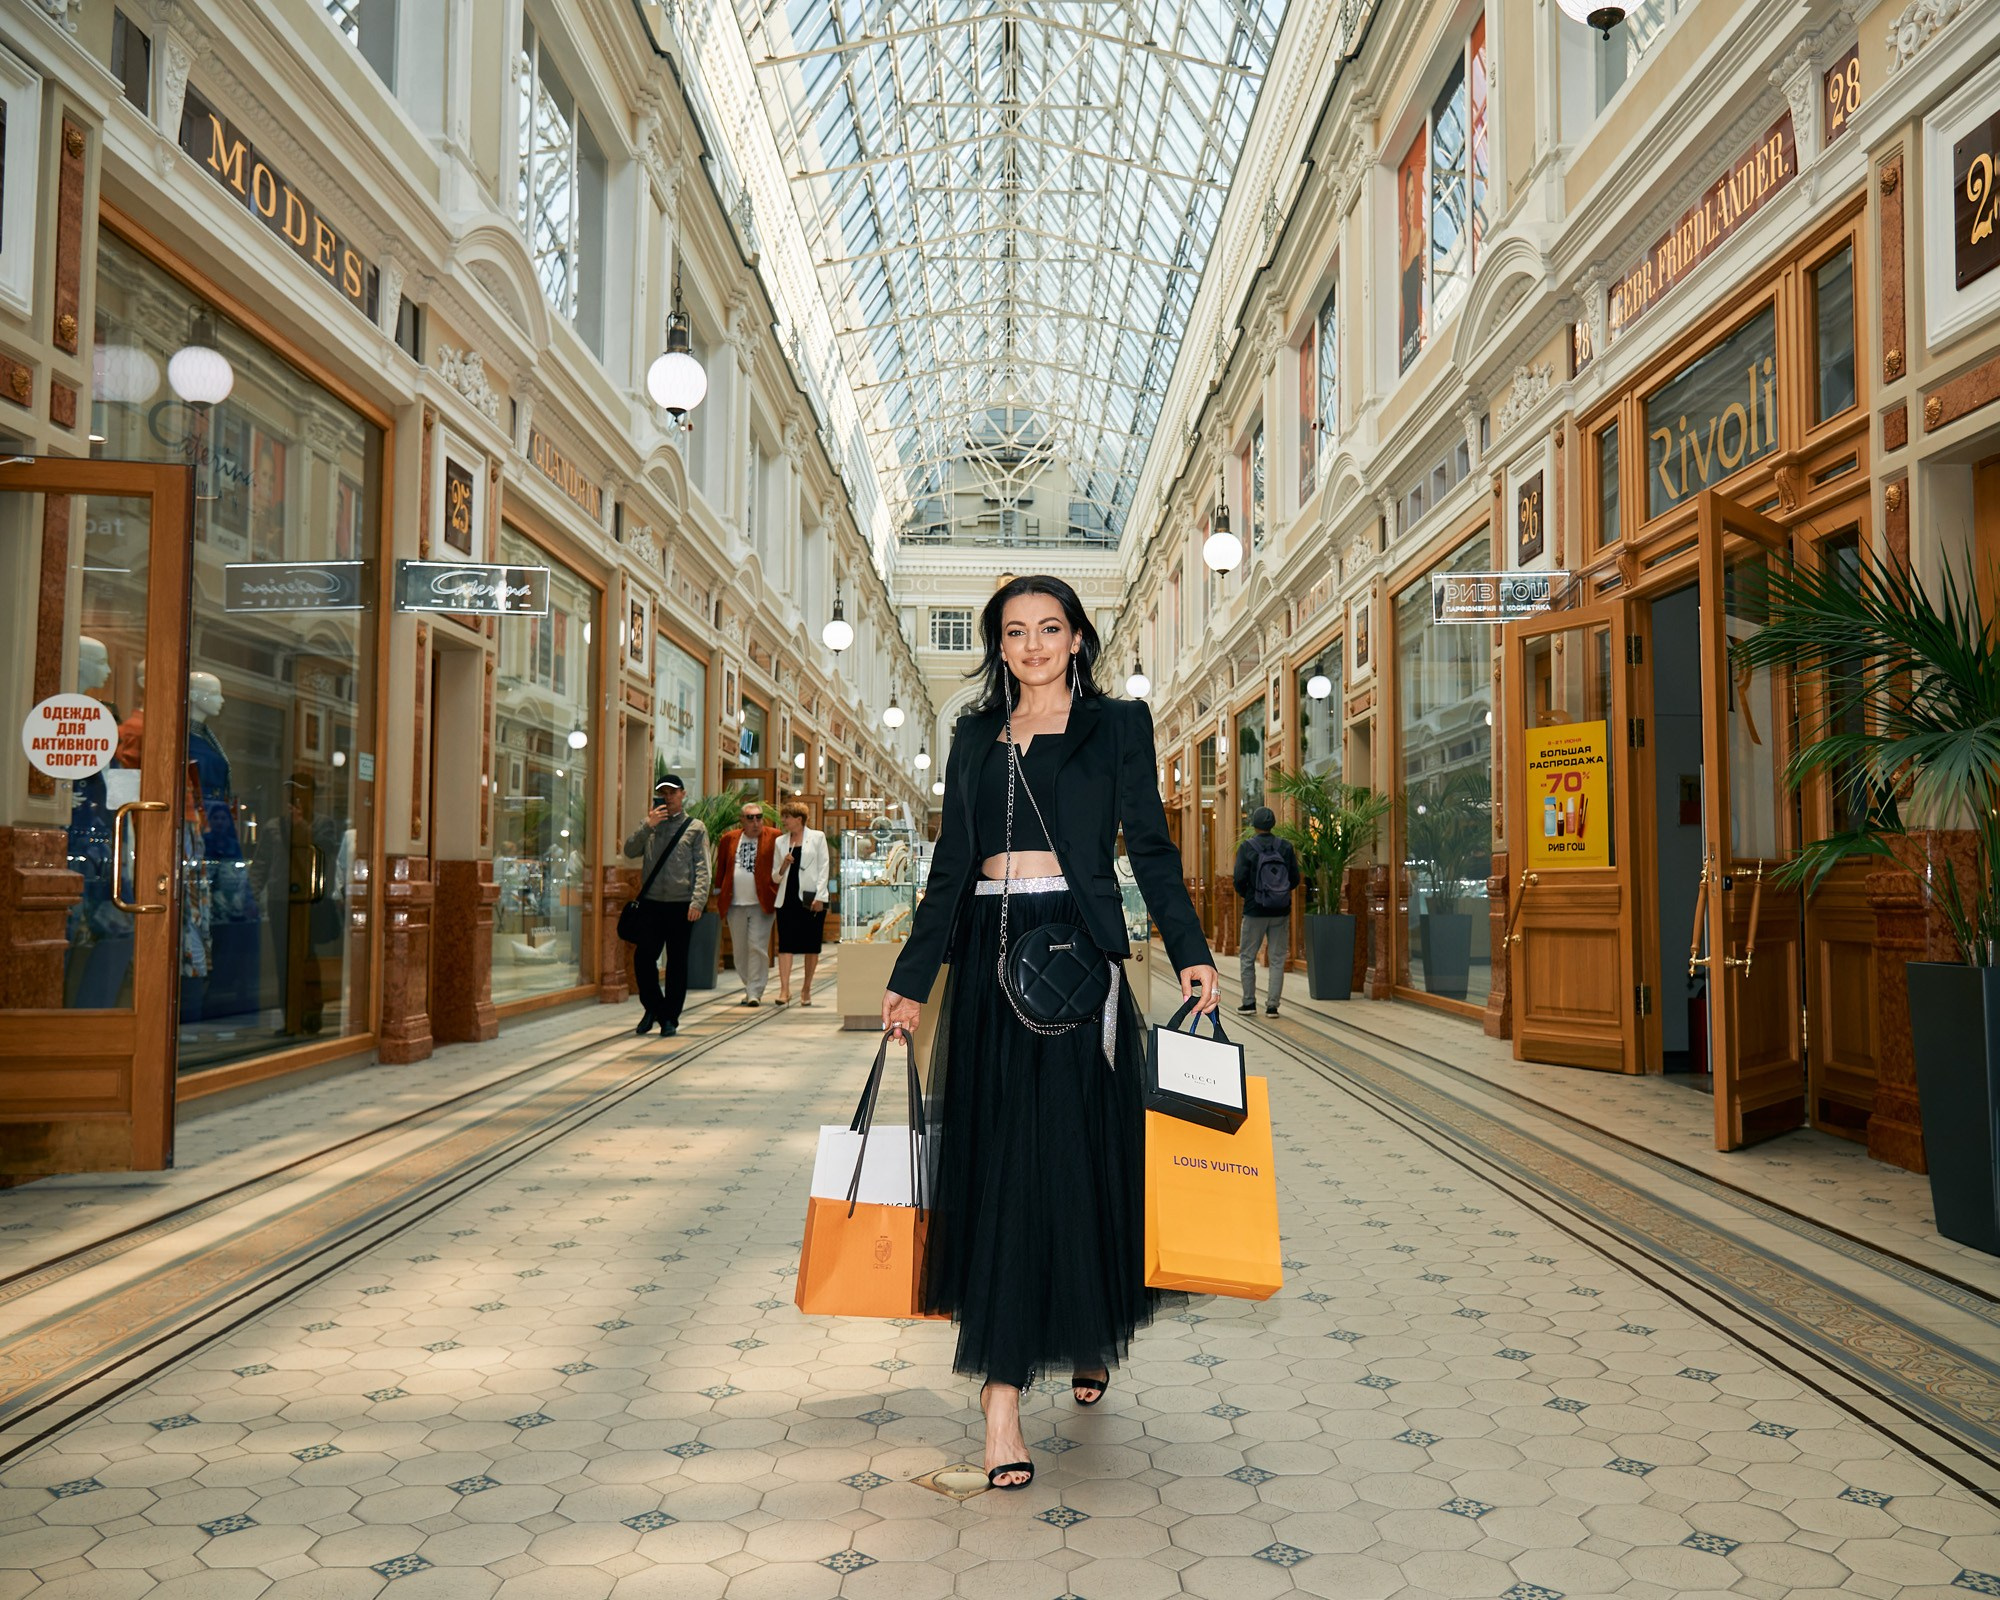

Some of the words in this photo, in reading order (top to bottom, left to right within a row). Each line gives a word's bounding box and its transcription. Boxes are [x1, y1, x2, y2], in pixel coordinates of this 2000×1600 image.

[1829, 57, 1861, 130] 28
[207, 112, 363, 298] MODES
[1966, 152, 2000, 245] 2
[1656, 131, 1789, 291] FRIEDLÄNDER.
[1575, 320, 1591, 369] 28
[1650, 355, 1777, 500] Rivoli
[451, 479, 471, 535] 25
[1521, 491, 1539, 546] 26
[1446, 583, 1495, 603] РИВ
[1499, 582, 1551, 601] ГОШ
[43, 706, 101, 721] ОДЕЖДА
[56, 722, 86, 736] ДЛЯ
[32, 737, 109, 751] АКТИВНОГО
[1540, 745, 1592, 758] БОЛЬШАЯ
[46, 753, 98, 767] СПОРТА
[1529, 755, 1604, 770] РАСПРОДАЖА
[1547, 843, 1566, 853] РИВ
[1566, 842, 1586, 851] ГОШ
[1184, 1072, 1216, 1085] GUCCI
[1173, 1155, 1208, 1169] LOUIS
[1210, 1160, 1259, 1177] VUITTON
